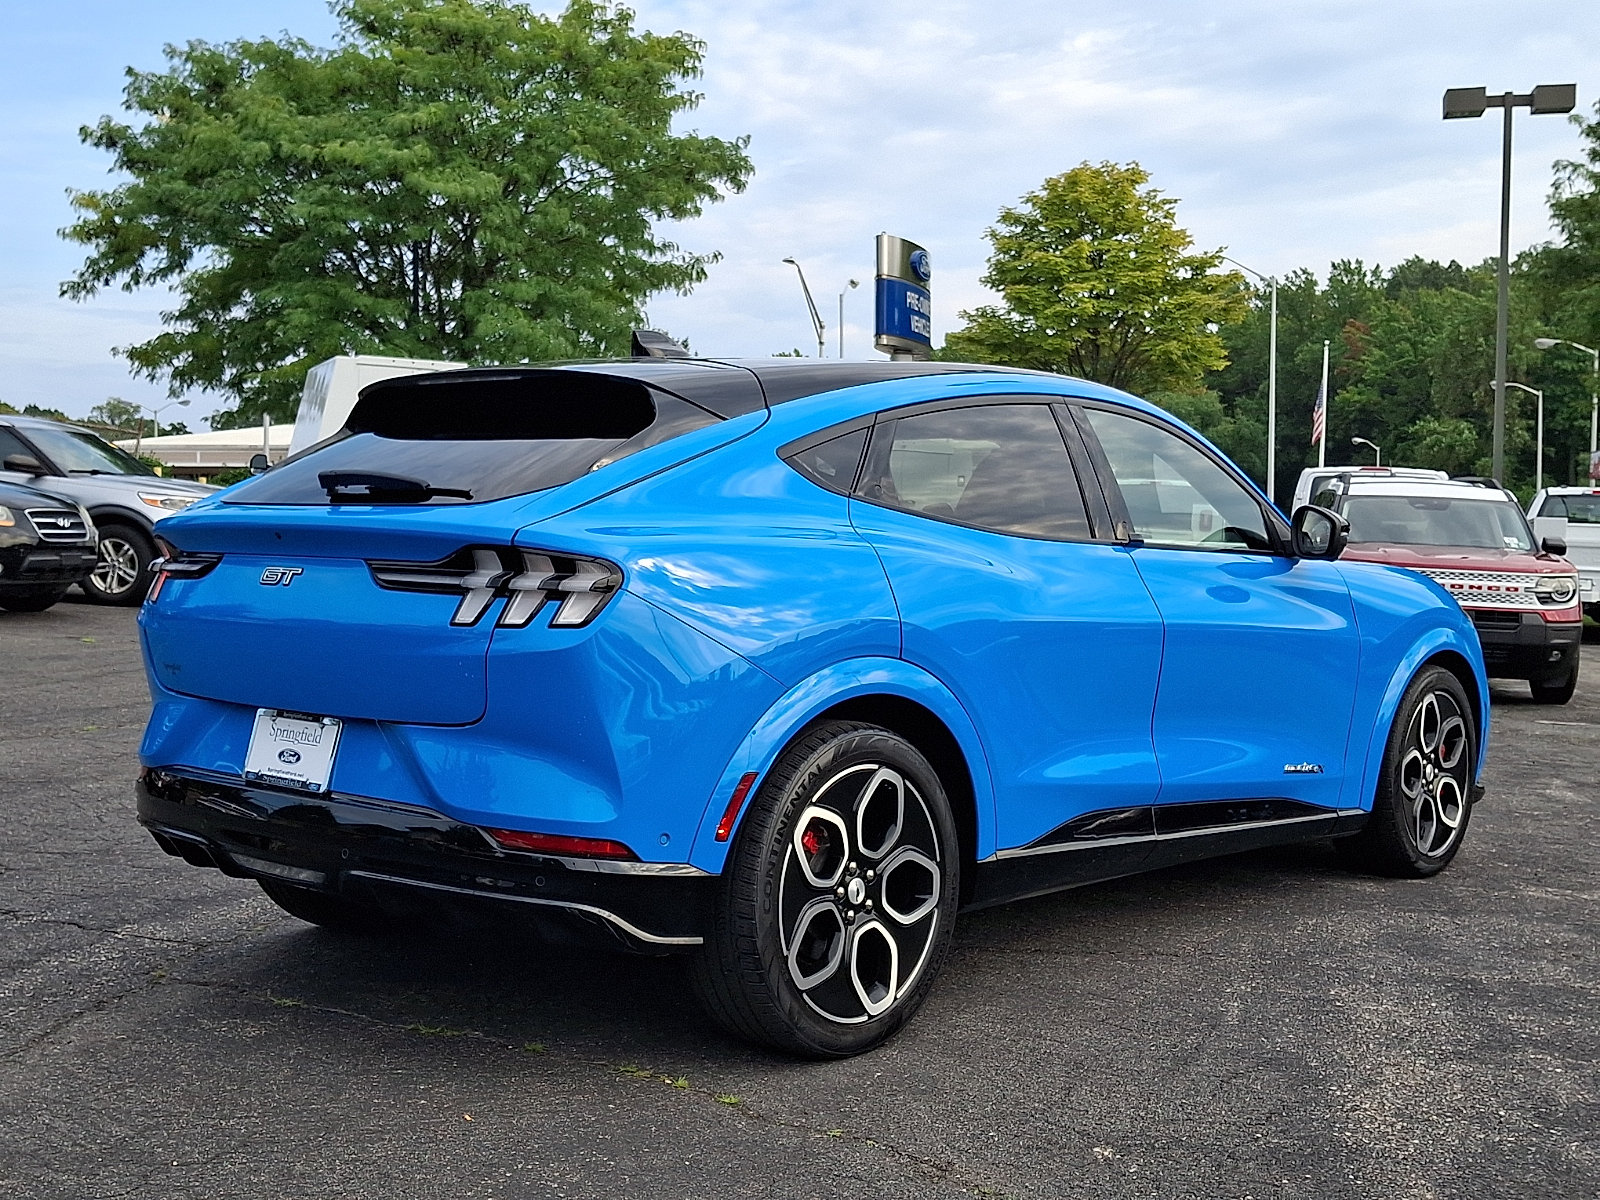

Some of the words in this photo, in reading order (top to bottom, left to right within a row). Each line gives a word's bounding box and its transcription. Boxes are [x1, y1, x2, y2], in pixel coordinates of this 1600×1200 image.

[259, 566, 303, 586] GT
[1440, 583, 1519, 593] ONCO
[269, 721, 322, 745] Springfield
[280, 750, 300, 763] Ford
[262, 775, 303, 788] Springfield
